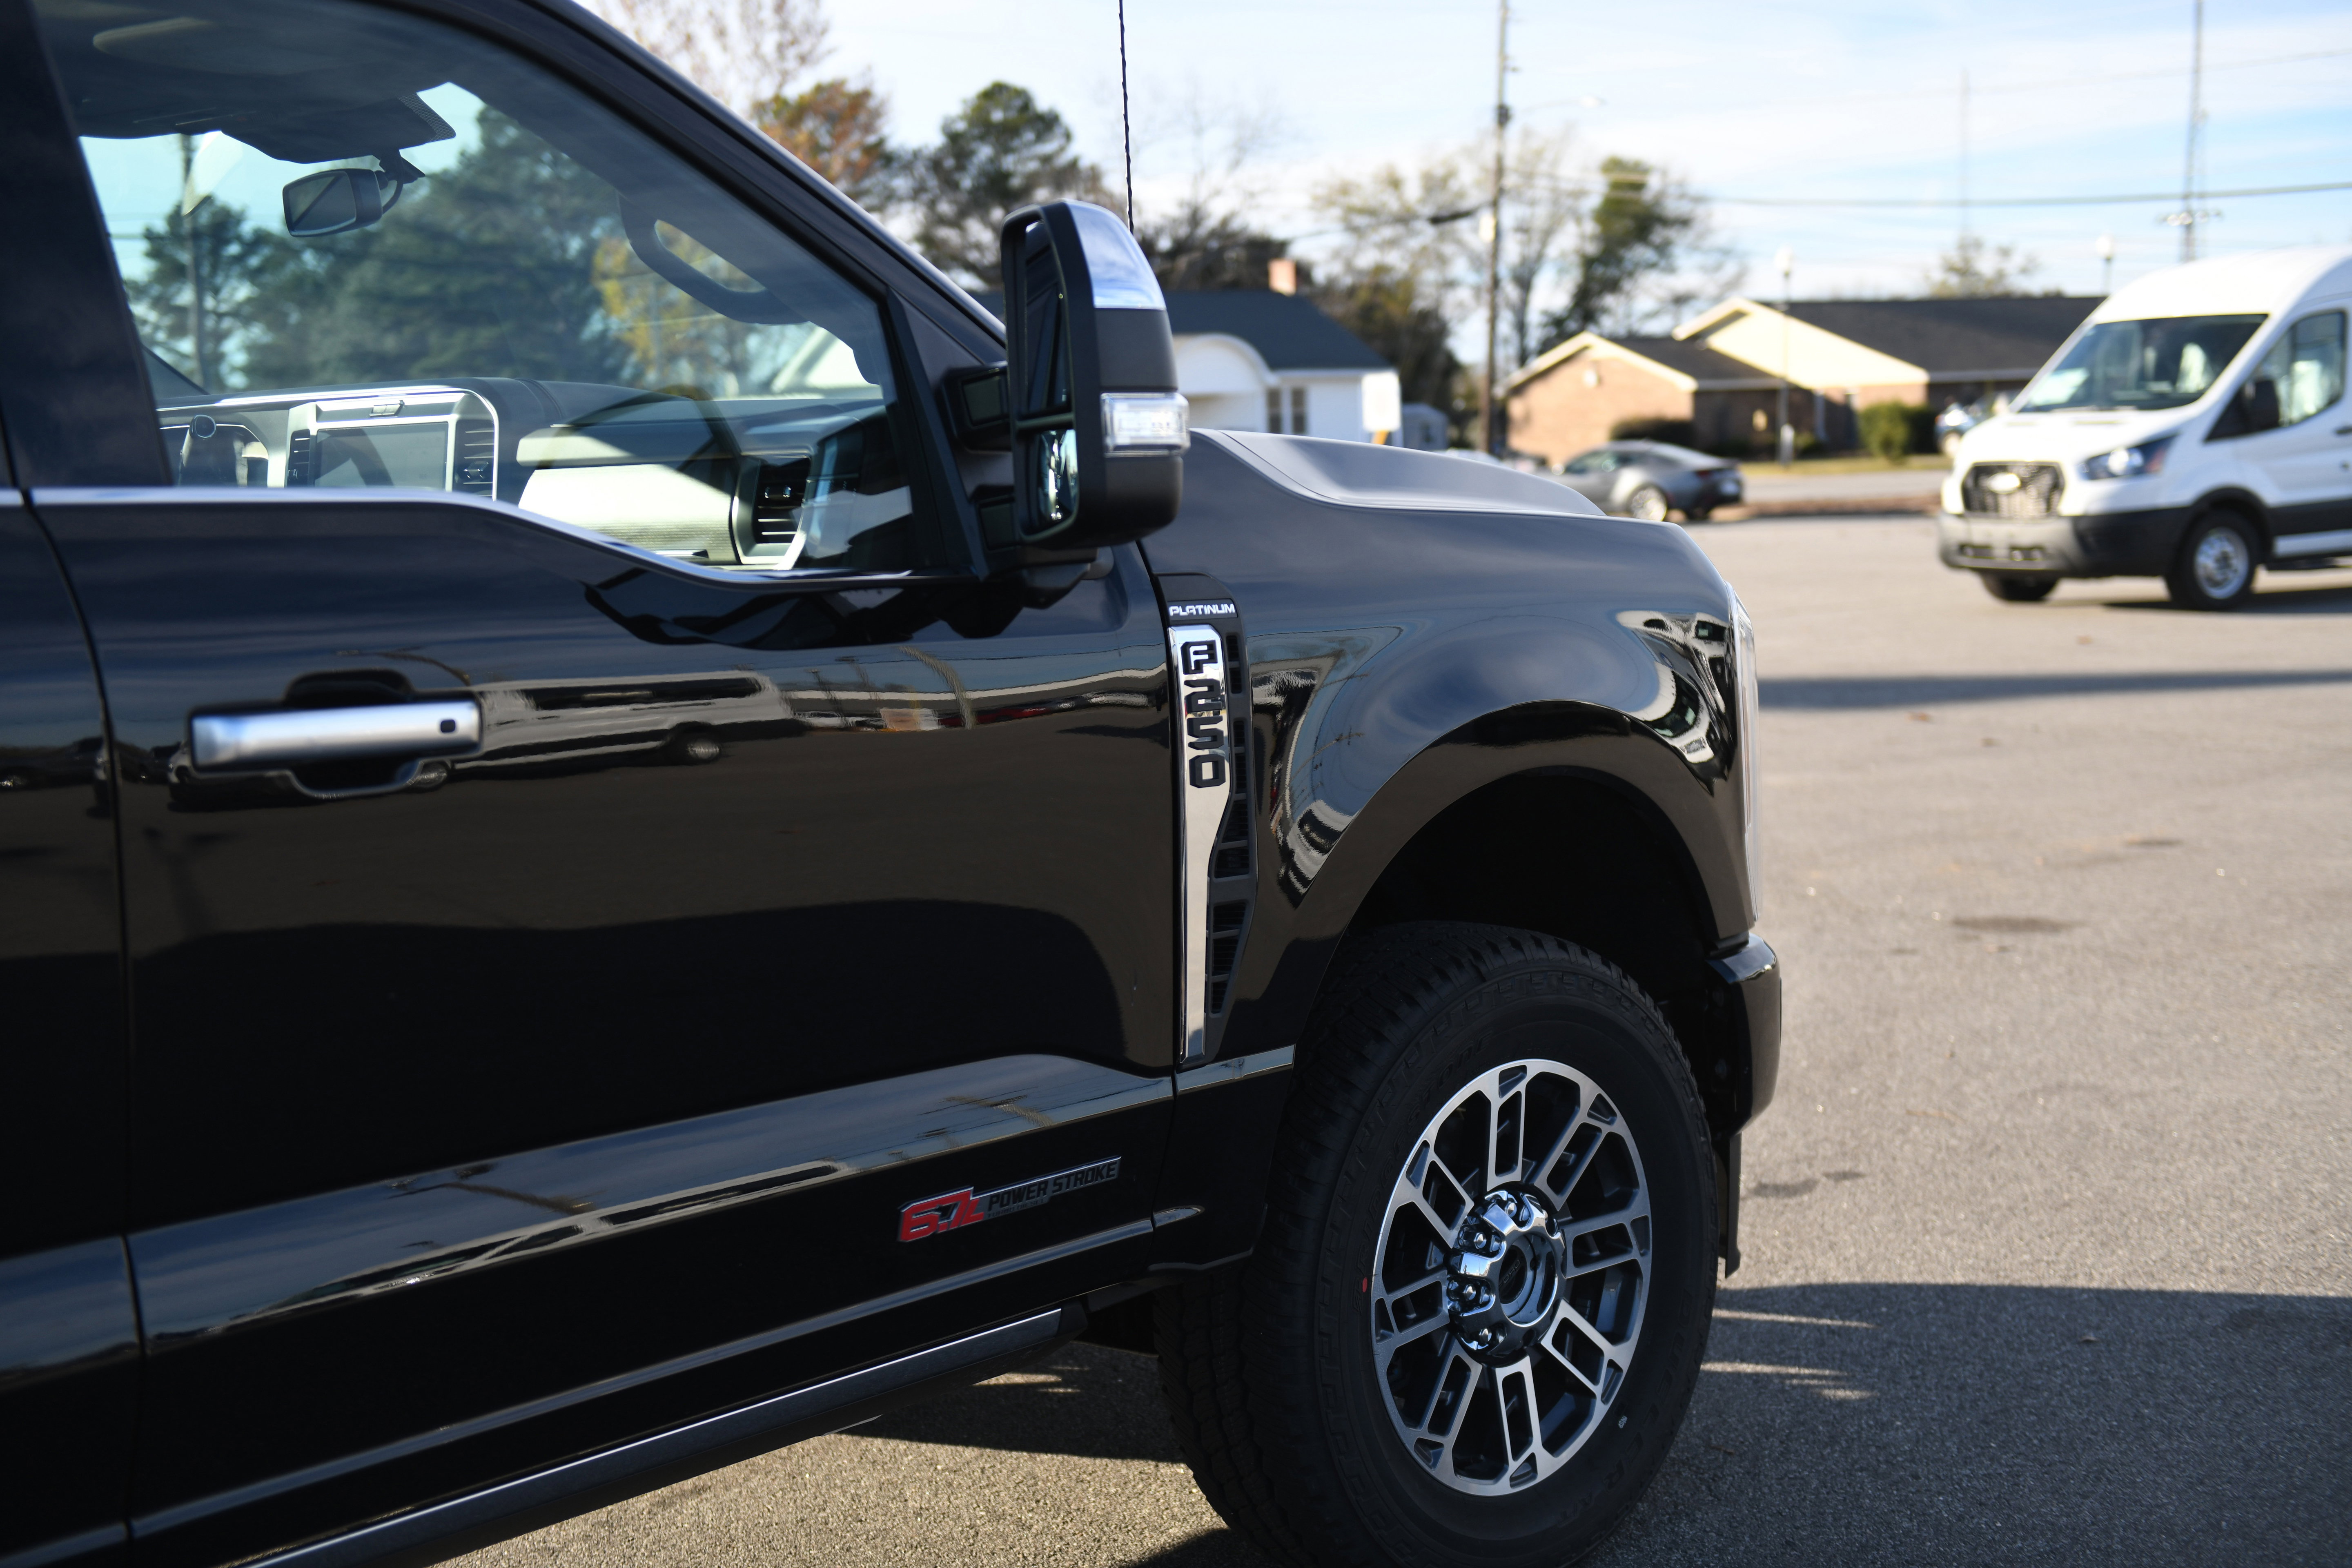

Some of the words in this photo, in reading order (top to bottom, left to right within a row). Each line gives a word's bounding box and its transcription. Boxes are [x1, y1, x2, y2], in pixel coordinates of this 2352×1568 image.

[1169, 603, 1235, 616] PLATINUM
[1180, 639, 1226, 789] F250
[900, 1189, 985, 1242] 6.7L
[987, 1181, 1048, 1212] POWER
[1052, 1161, 1118, 1194] STROKE
[987, 1206, 1015, 1218] TURBO
[1017, 1198, 1045, 1211] DIESEL
[1352, 1026, 1494, 1316] BRIDGESTONE
